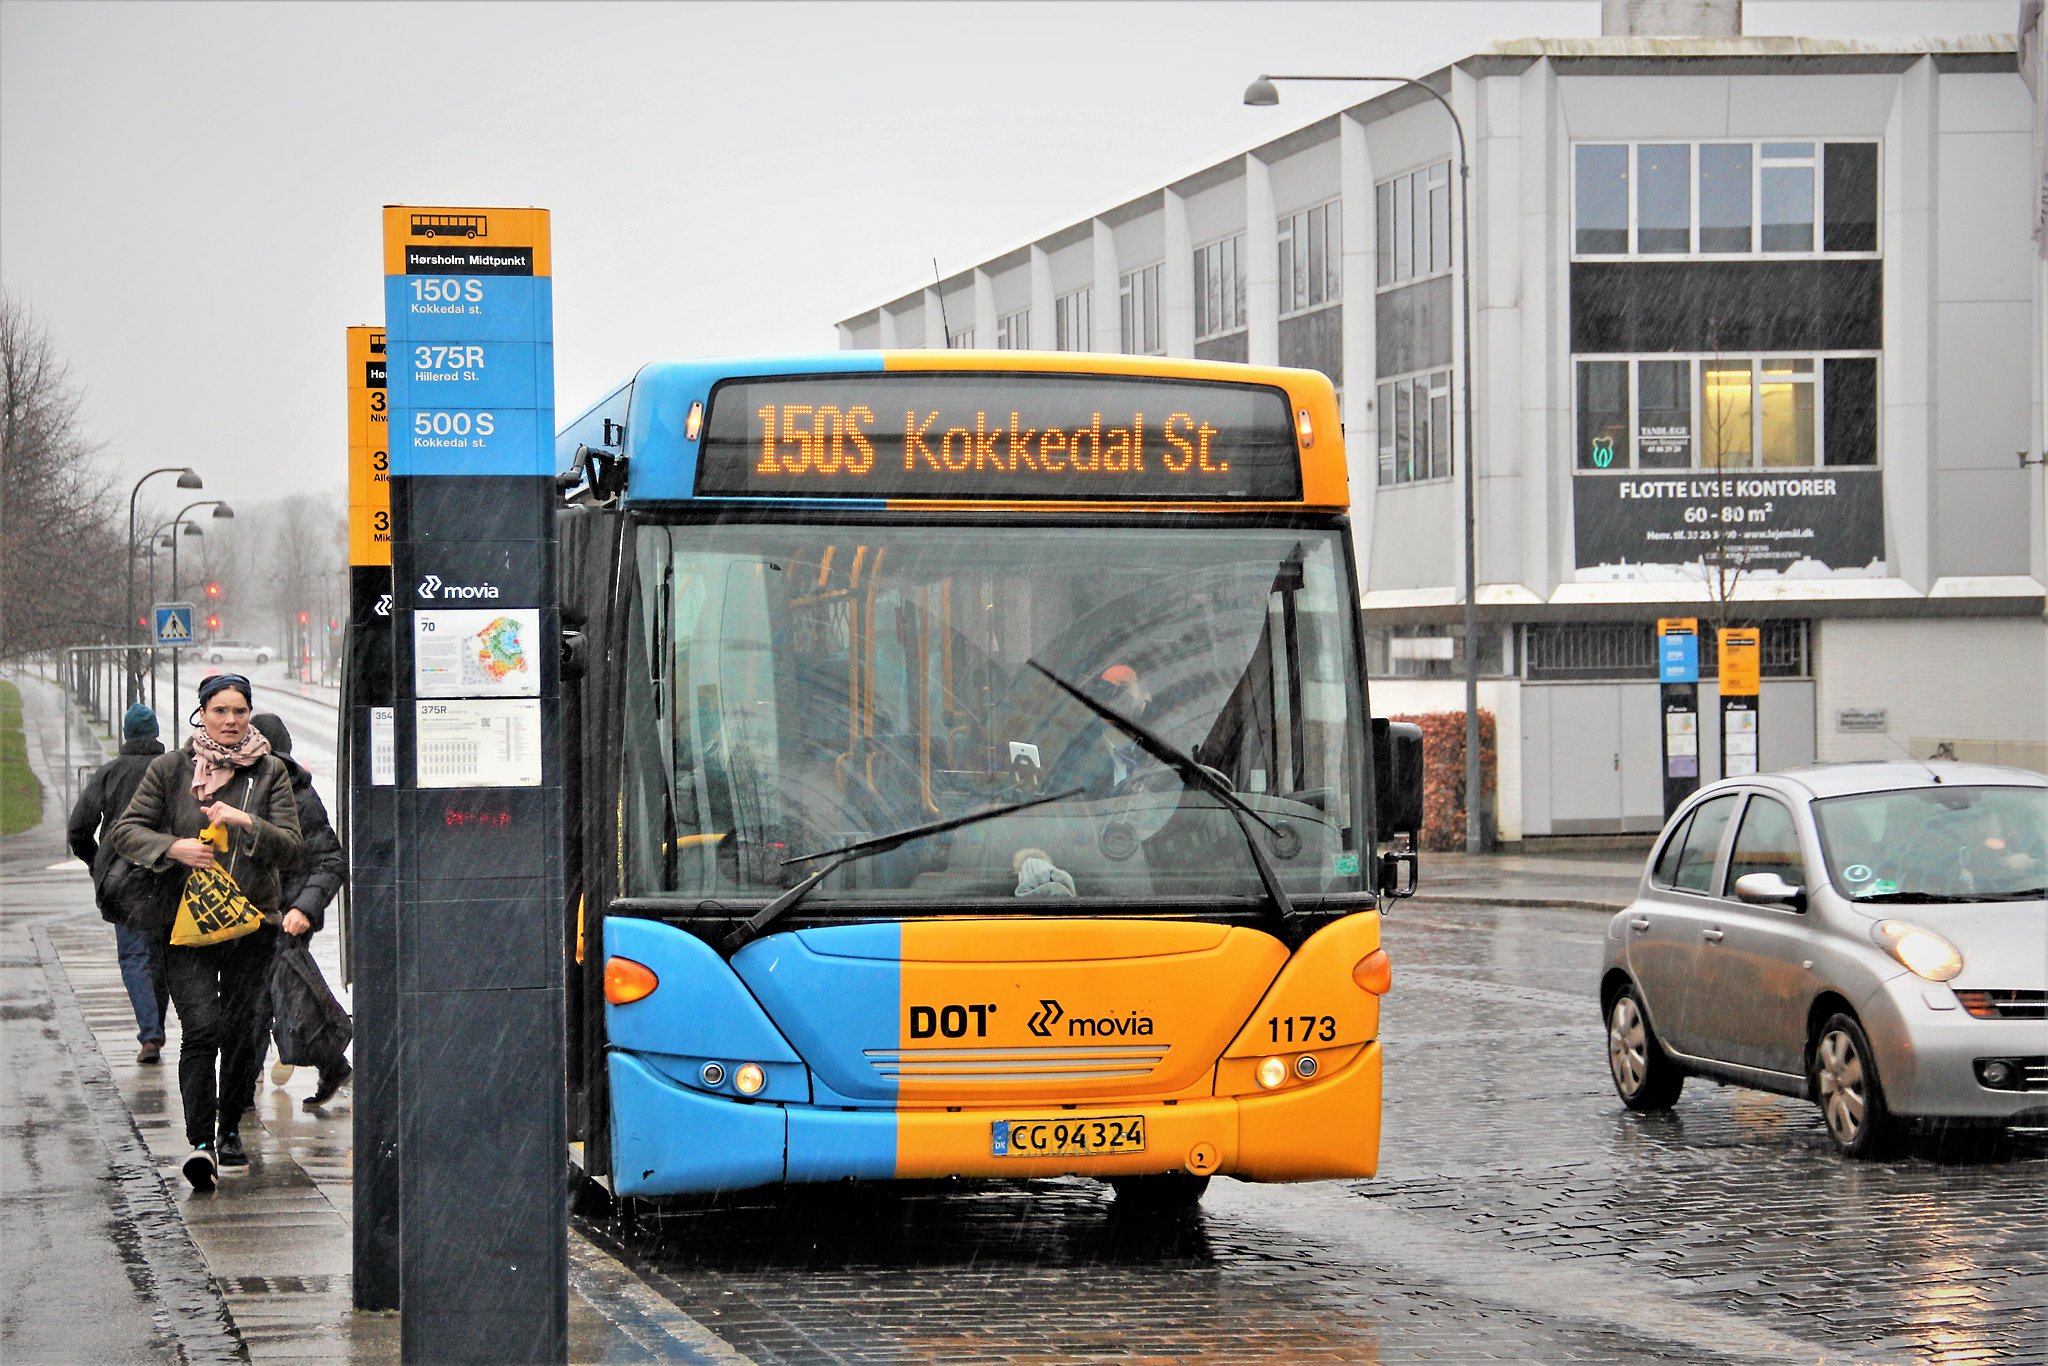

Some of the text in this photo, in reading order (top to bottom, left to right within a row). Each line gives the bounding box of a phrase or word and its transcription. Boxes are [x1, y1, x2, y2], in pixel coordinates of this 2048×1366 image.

[410, 254, 526, 267] Hørsholm Midtpunkt
[411, 303, 482, 314] Kokkedal st.
[414, 345, 485, 369] 375R
[463, 371, 479, 381] St.
[414, 437, 486, 448] Kokkedal st.
[756, 404, 1231, 475] 150S Kokkedal St.
[1619, 479, 1837, 499] FLOTTE LYSE KONTORER
[1684, 506, 1708, 522] 60
[1721, 506, 1745, 522] 80
[444, 582, 500, 599] movia
[421, 622, 436, 632] 70
[421, 705, 447, 714] 375R
[910, 1003, 1154, 1039] DOT movia
[1268, 1015, 1337, 1043] 1173
[994, 1142, 1006, 1150] DK
